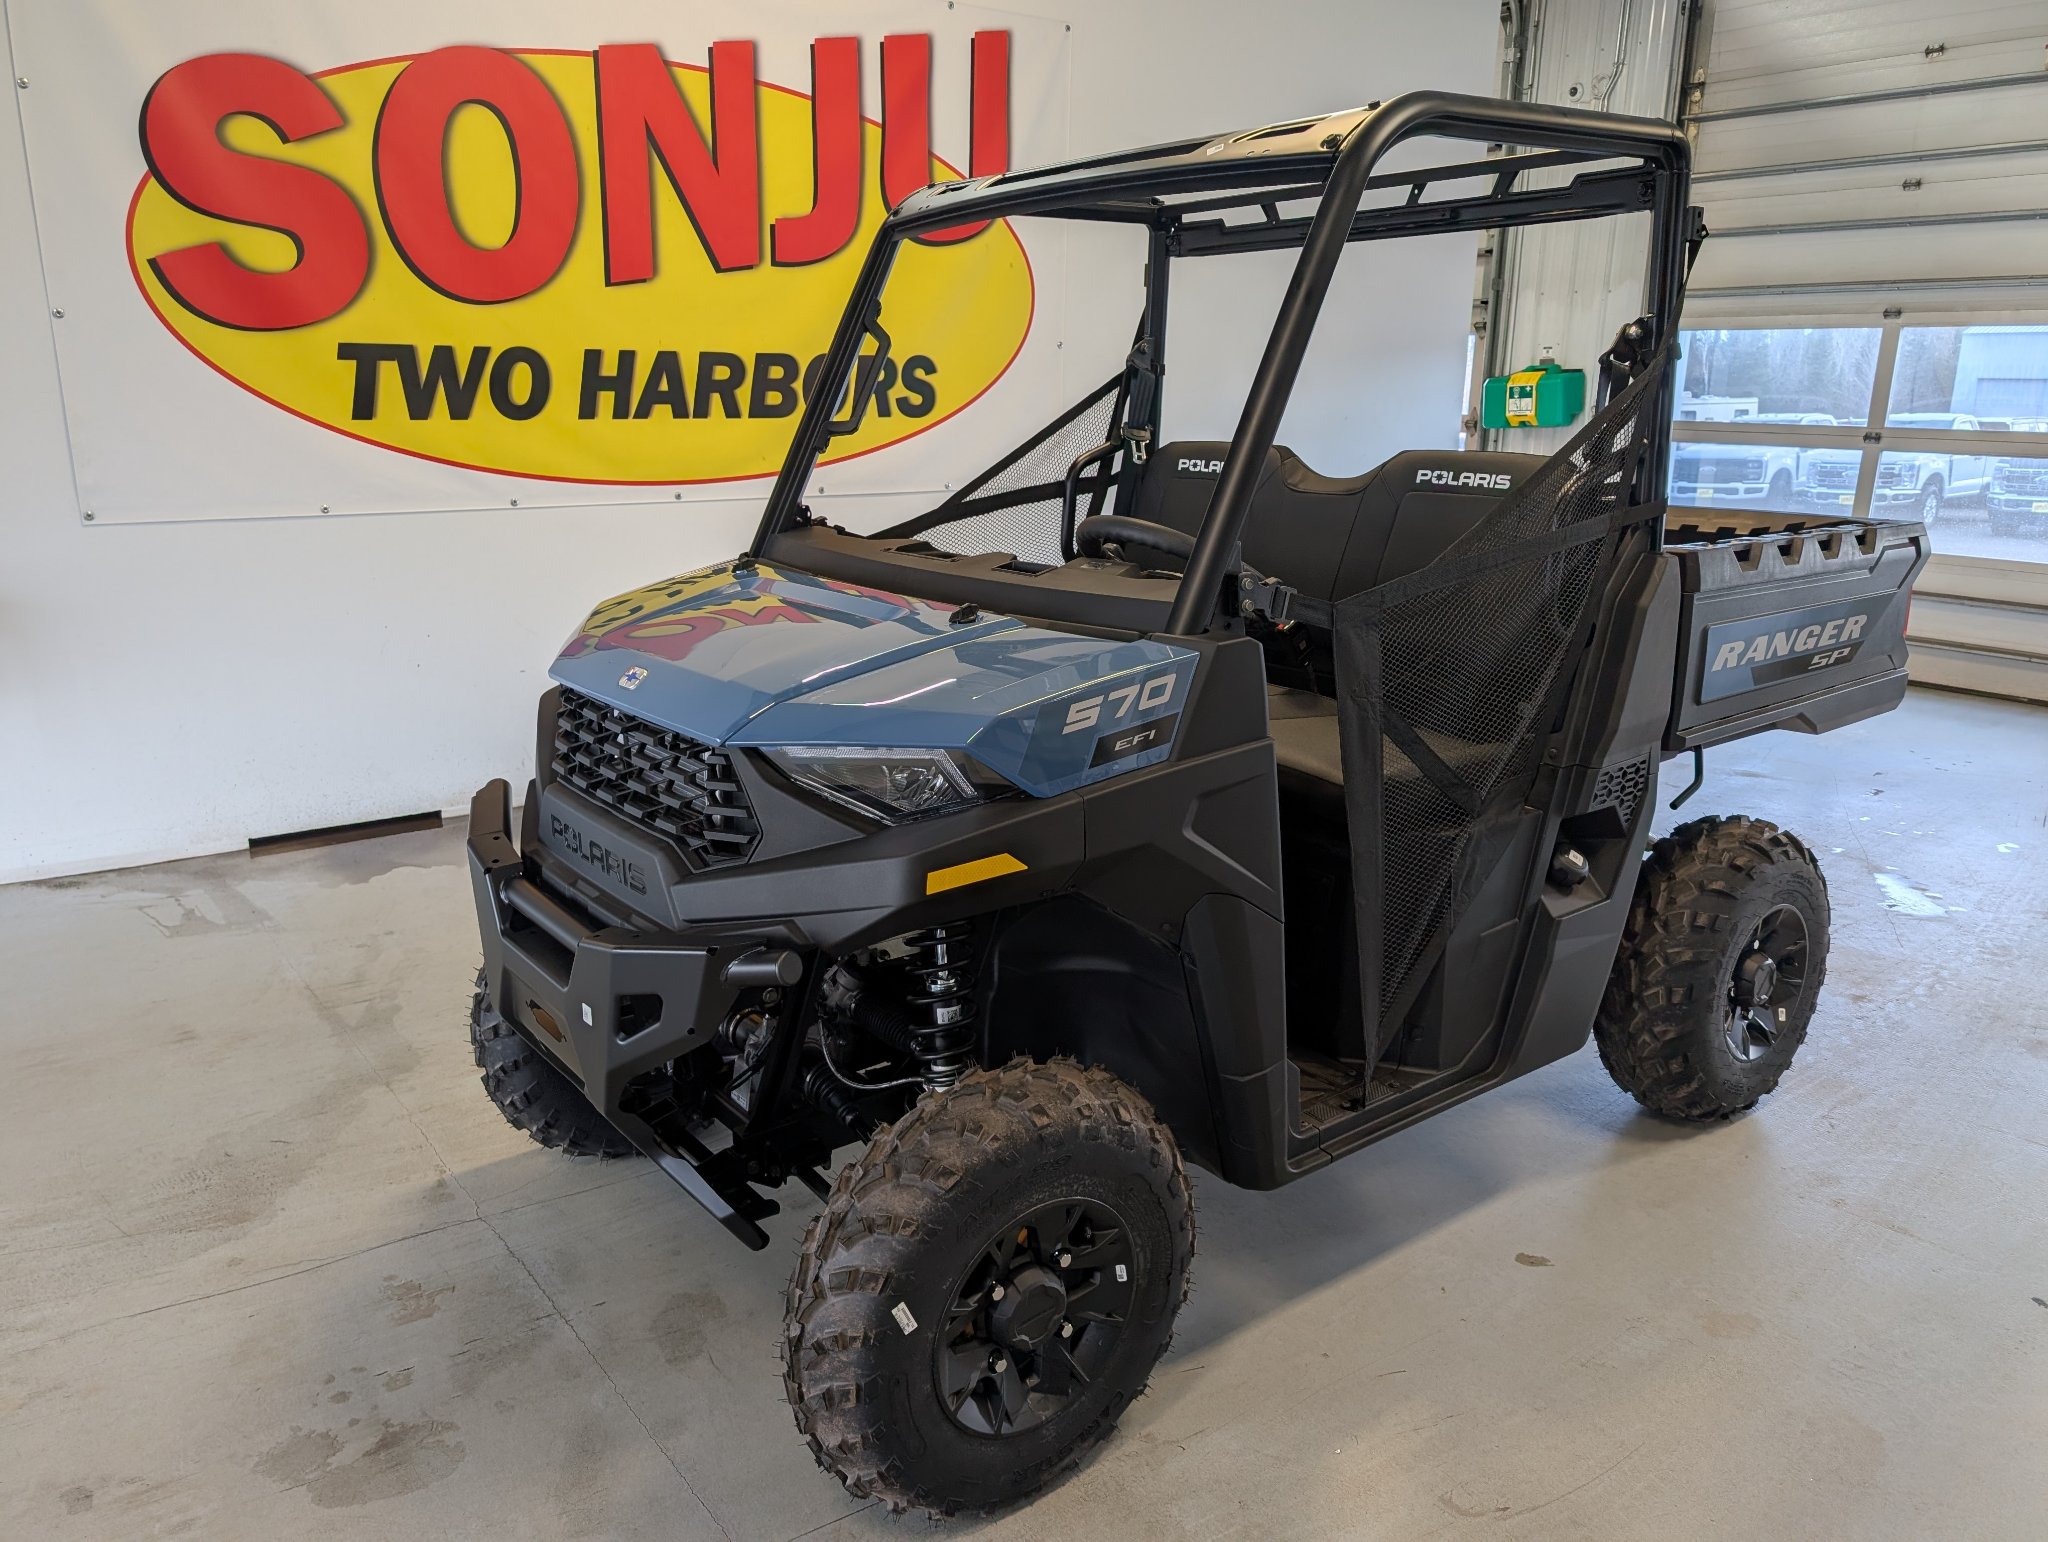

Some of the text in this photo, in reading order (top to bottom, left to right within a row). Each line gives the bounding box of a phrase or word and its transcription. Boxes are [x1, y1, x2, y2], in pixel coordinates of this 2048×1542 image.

[140, 30, 1009, 331] SONJU
[337, 343, 551, 421] TWO
[1416, 470, 1511, 489] POLARIS
[1711, 614, 1867, 672] RANGER
[1807, 647, 1851, 669] SP
[1062, 673, 1176, 735] 570
[1114, 729, 1156, 751] EFI
[551, 813, 647, 896] POLARIS
